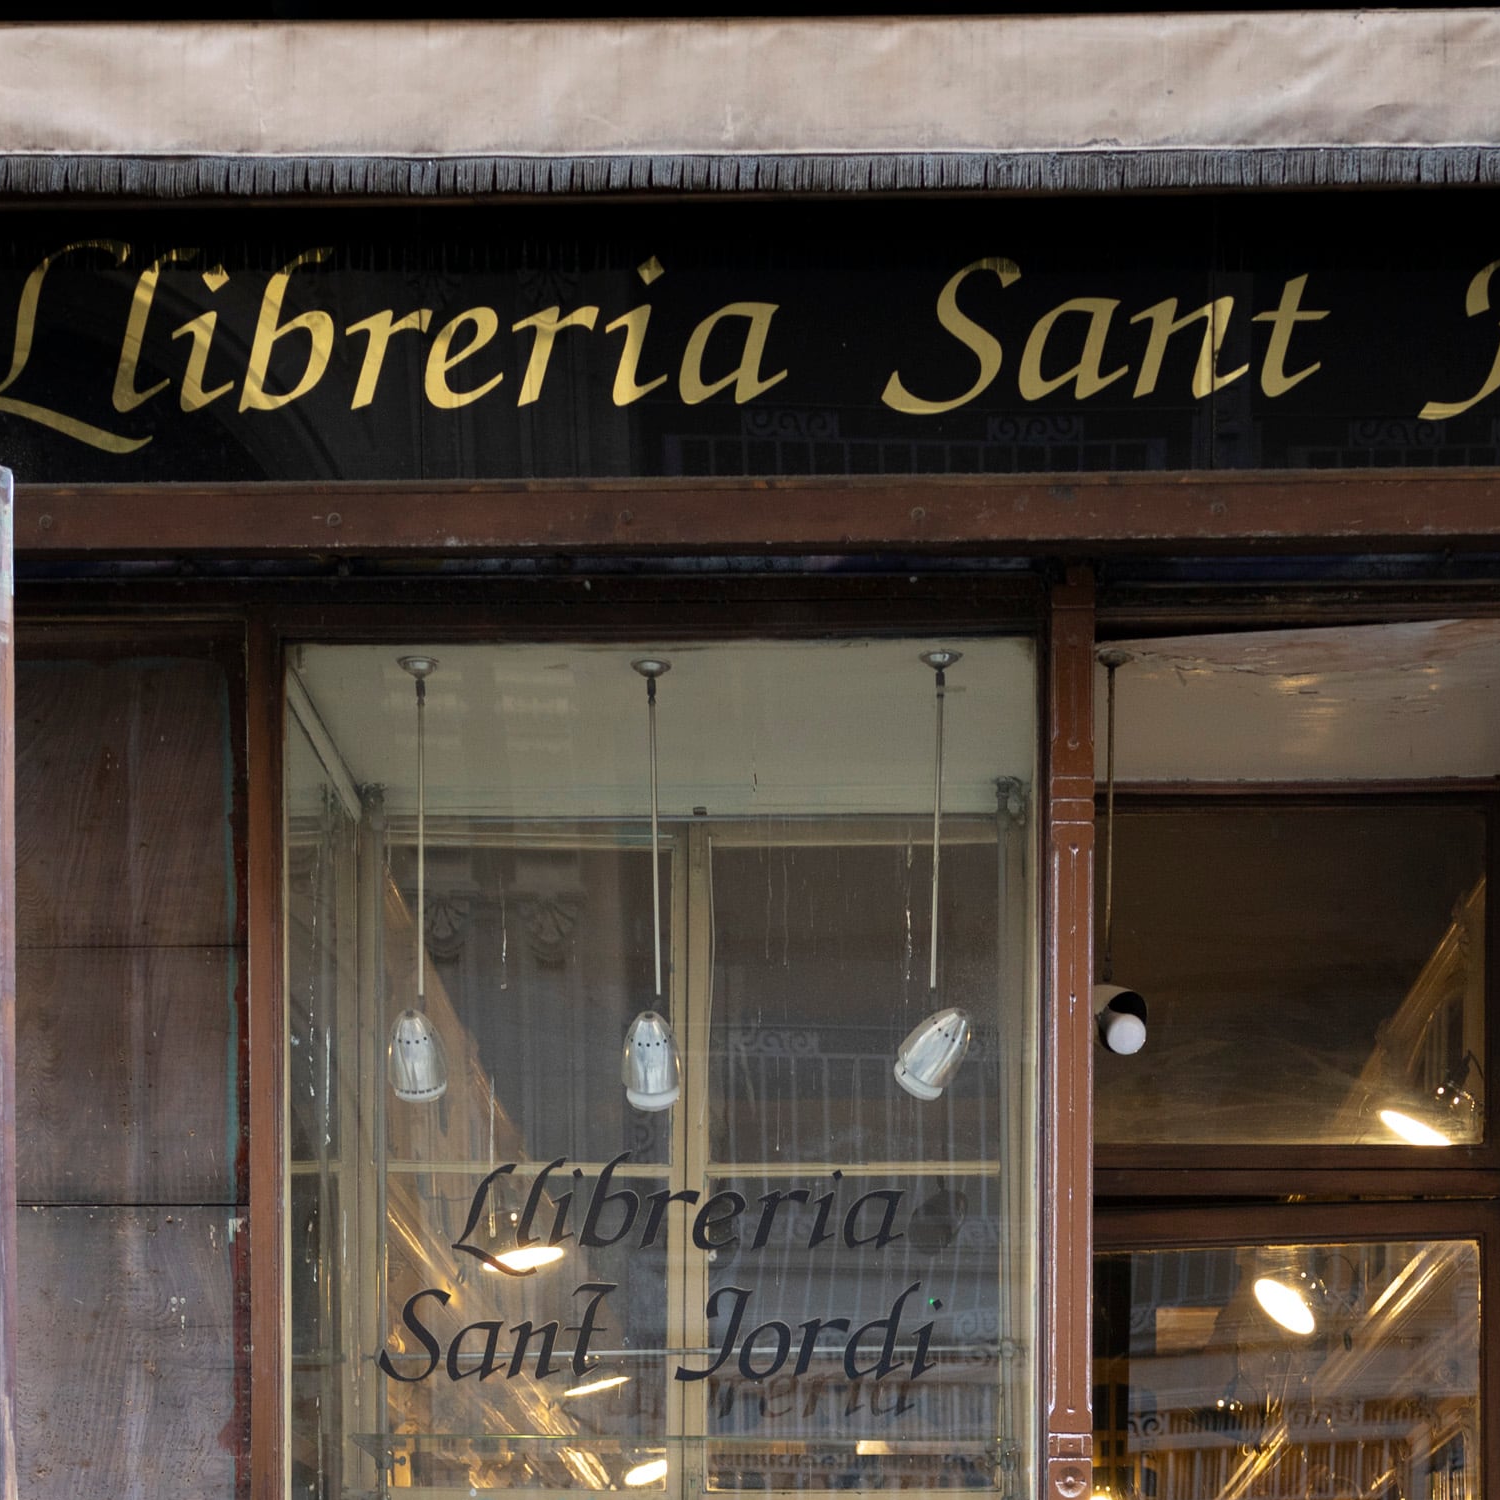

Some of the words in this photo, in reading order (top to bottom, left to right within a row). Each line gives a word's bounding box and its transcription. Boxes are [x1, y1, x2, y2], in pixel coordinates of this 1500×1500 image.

[880, 256, 1332, 416] Sant
[451, 1150, 907, 1278] Llibreria
[378, 1281, 619, 1383] Sant
[674, 1280, 943, 1382] Jordi
